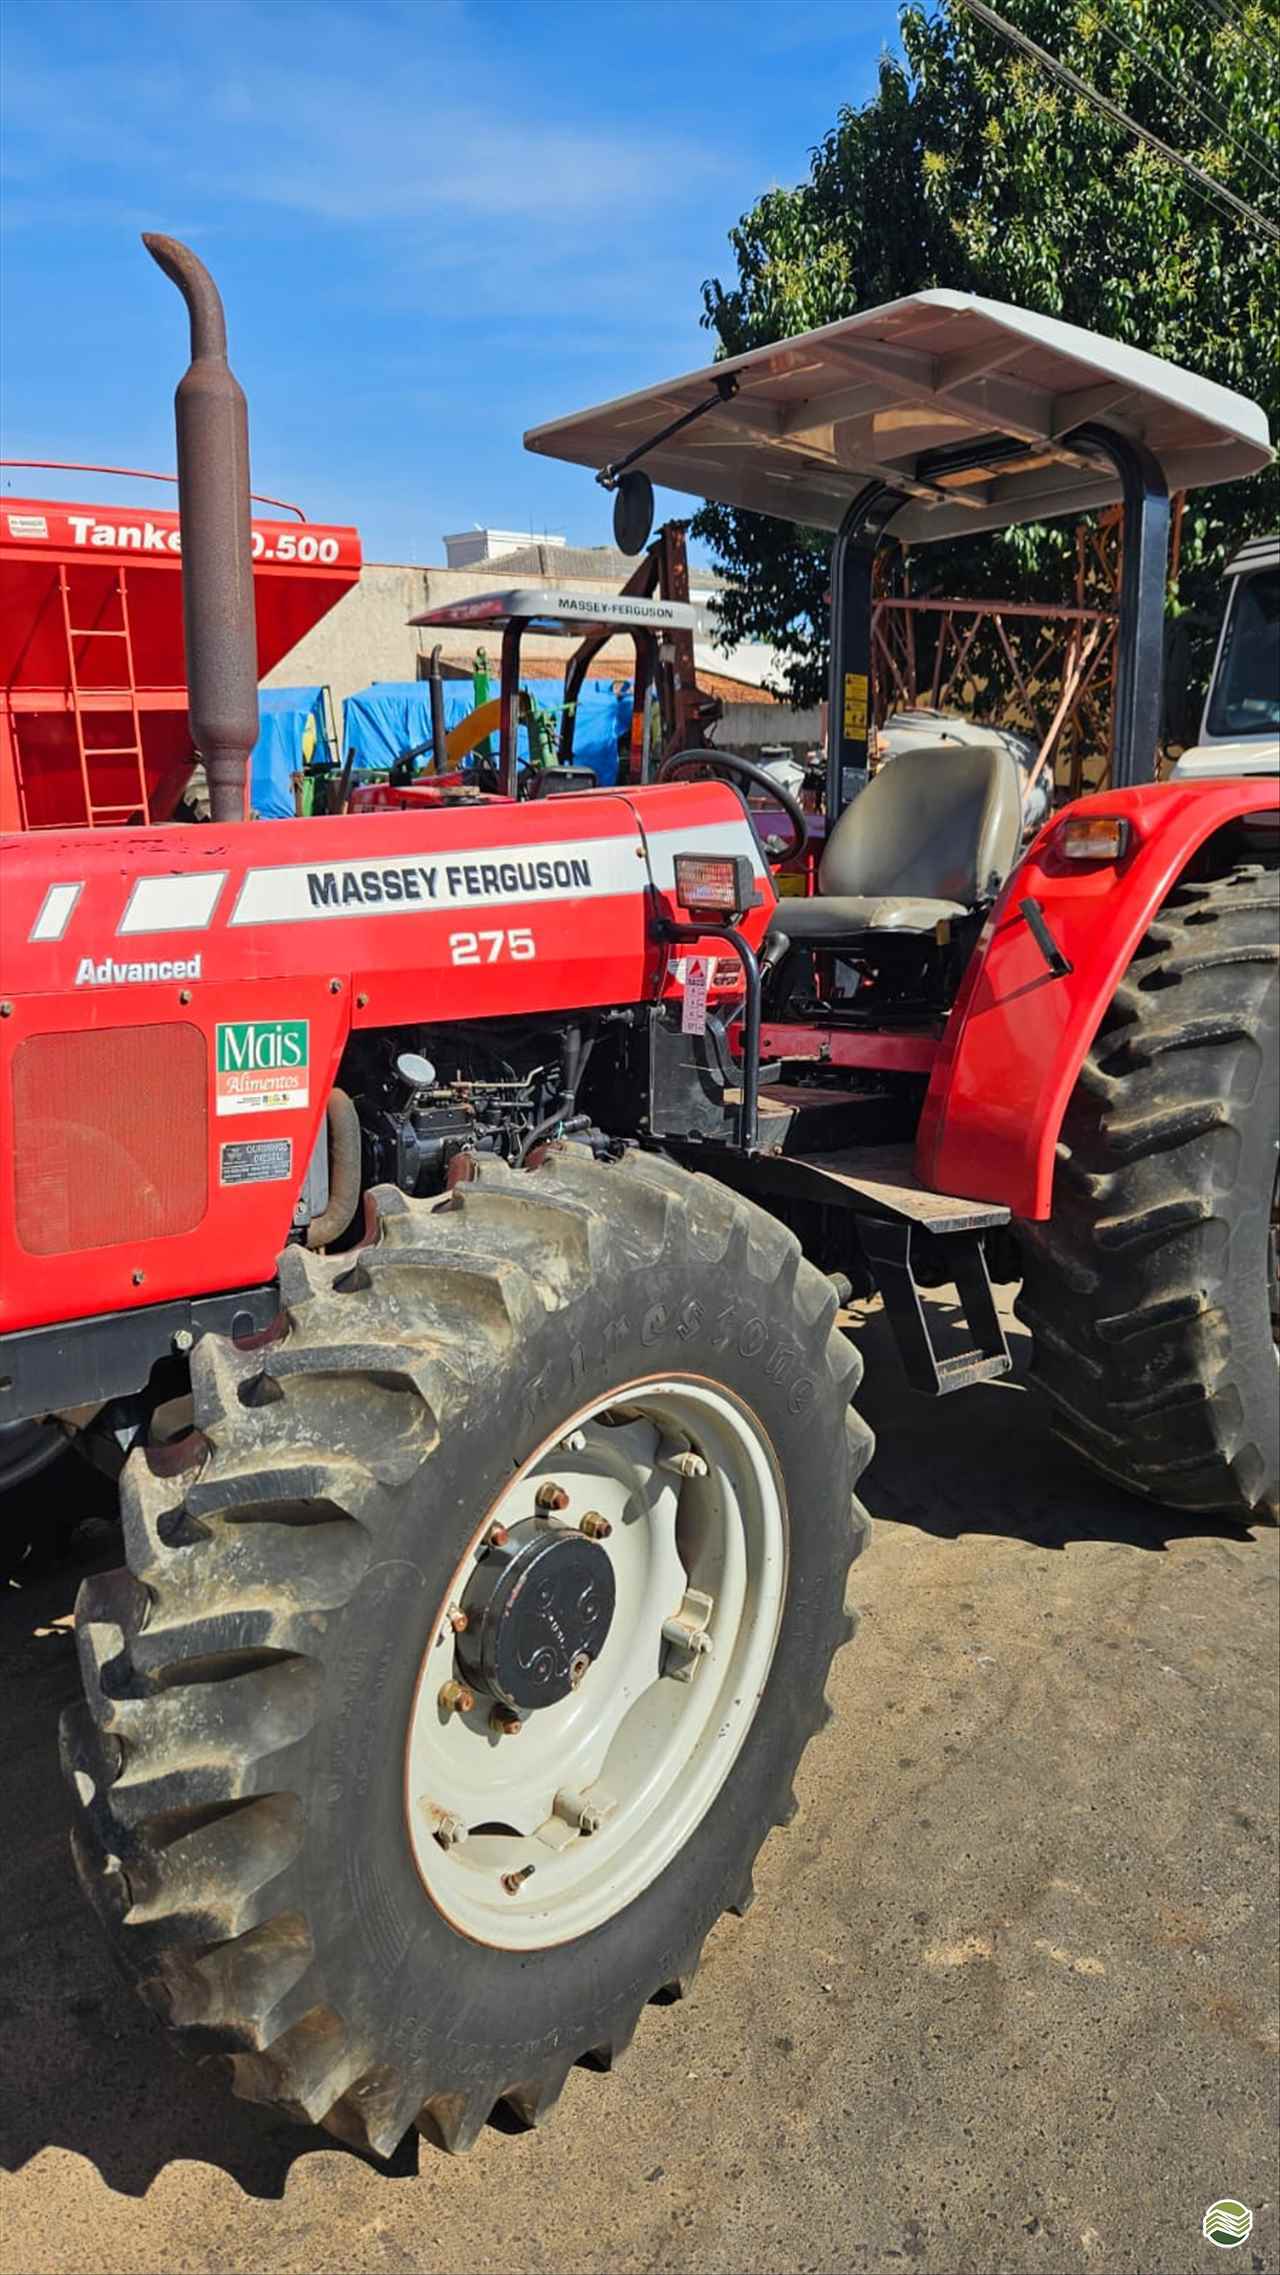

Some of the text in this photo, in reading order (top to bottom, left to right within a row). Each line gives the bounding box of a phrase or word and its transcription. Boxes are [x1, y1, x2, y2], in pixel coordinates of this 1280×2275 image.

[67, 516, 181, 552] Tanke
[252, 531, 339, 564] 0.500
[306, 859, 592, 908] MASSEY FERGUSON
[449, 928, 536, 966] 275
[75, 953, 202, 985] Advanced
[224, 1024, 302, 1070] Mais
[226, 1072, 298, 1093] Alimentos
